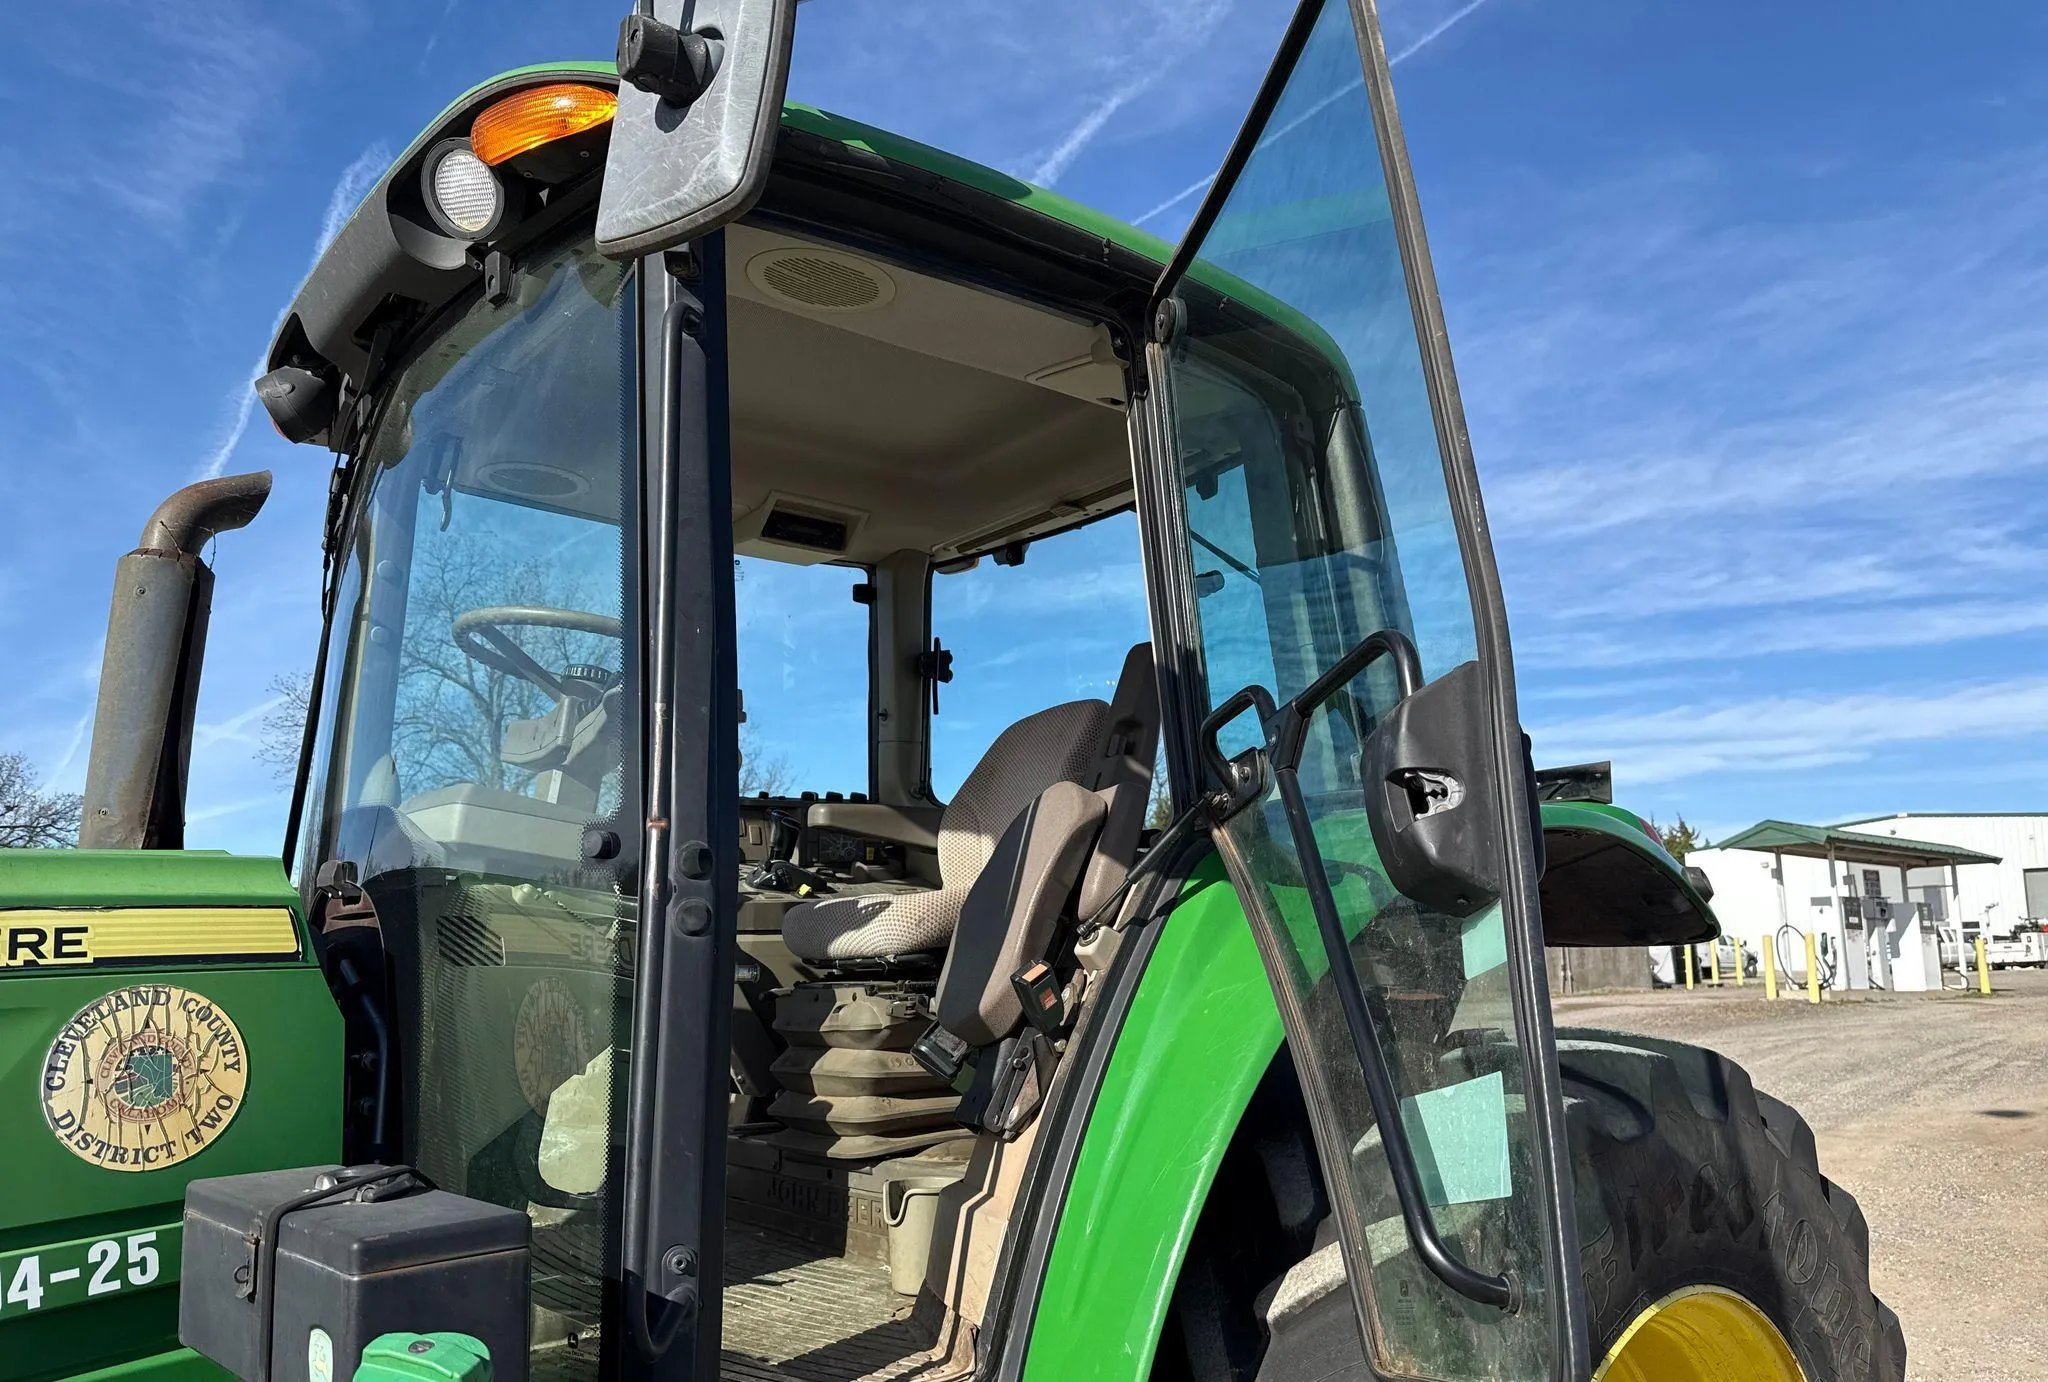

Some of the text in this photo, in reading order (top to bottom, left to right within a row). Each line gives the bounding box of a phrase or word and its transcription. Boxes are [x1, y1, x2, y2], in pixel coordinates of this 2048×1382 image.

[0, 927, 88, 960] RE
[45, 989, 241, 1092] CLEVELAND COUNTY
[53, 1094, 234, 1165] DISTRICT TWO
[826, 1190, 888, 1230] DEER
[0, 1231, 160, 1310] 4-25
